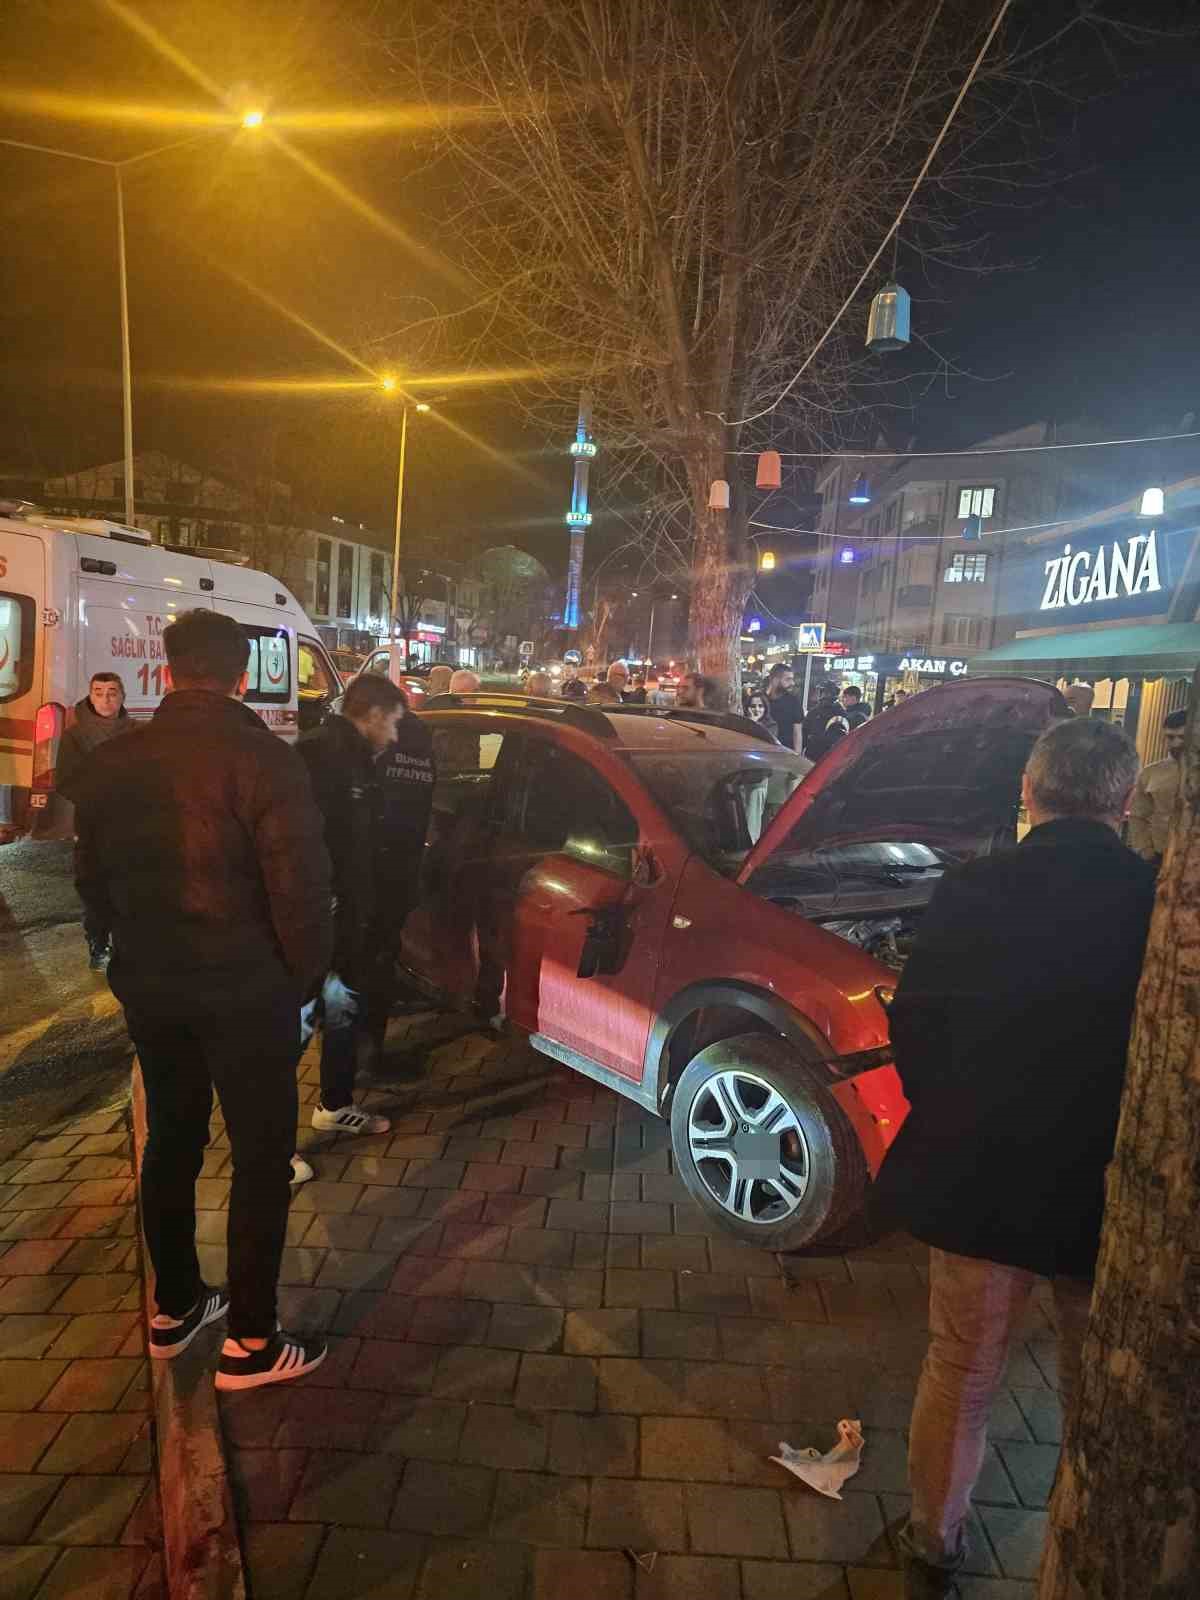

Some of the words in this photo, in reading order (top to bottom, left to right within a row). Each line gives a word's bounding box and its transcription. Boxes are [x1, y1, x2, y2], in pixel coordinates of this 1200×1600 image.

[1040, 529, 1162, 610] ZİGANA
[112, 634, 146, 659] SAĞLIK
[898, 657, 946, 674] AKAN
